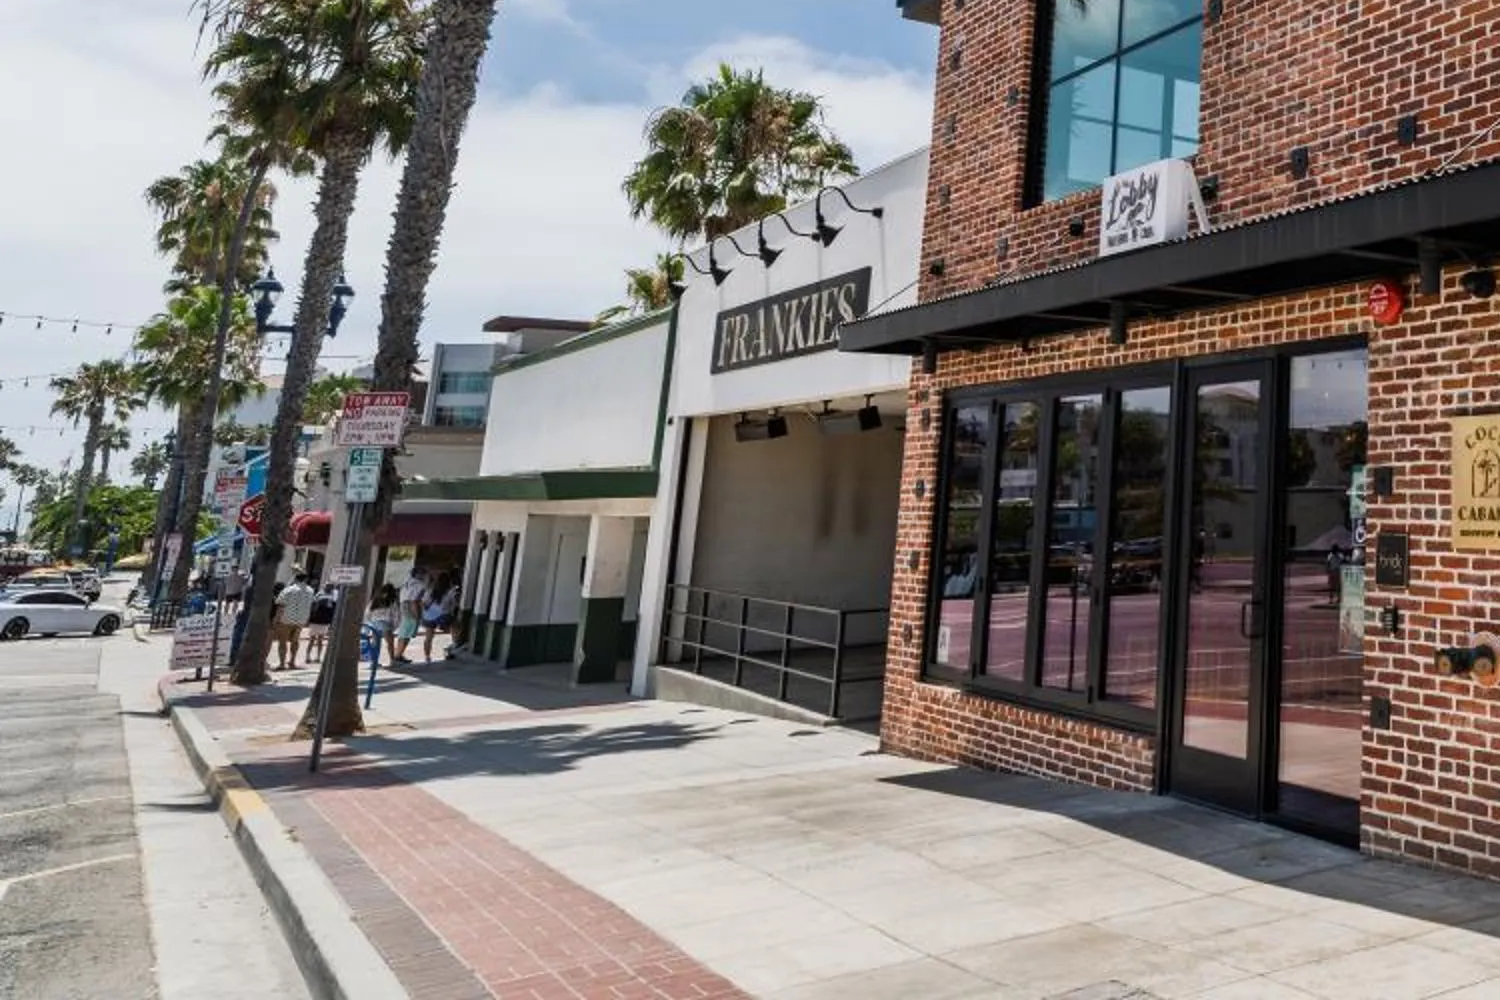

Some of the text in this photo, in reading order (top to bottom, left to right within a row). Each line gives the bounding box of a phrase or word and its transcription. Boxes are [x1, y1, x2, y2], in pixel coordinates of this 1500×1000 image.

[1106, 171, 1159, 230] Lobby
[373, 395, 405, 406] AWAY
[344, 407, 402, 418] NO PARKING
[346, 420, 397, 431] THURSDAY
